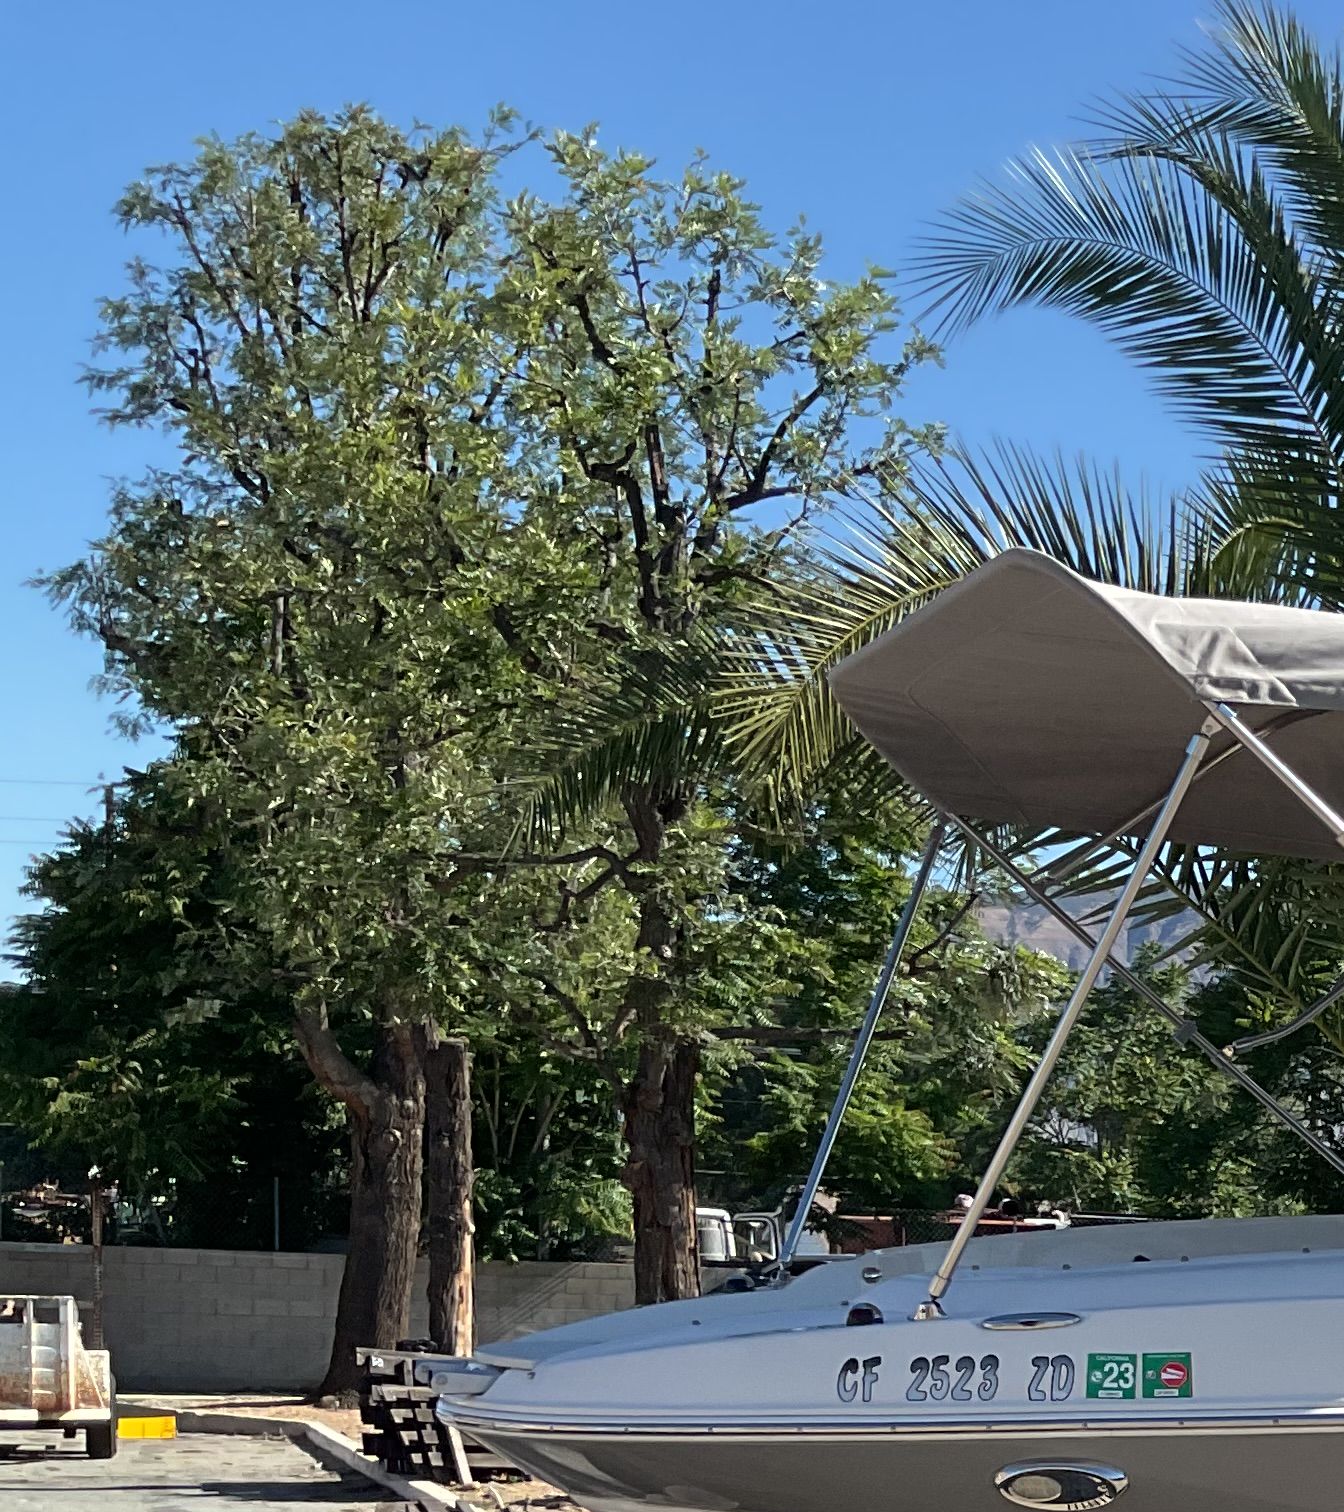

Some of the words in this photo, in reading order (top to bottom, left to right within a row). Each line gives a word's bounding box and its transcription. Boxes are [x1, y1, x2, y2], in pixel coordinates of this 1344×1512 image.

[836, 1356, 882, 1402] CF
[906, 1354, 1000, 1402] 2523
[1028, 1354, 1076, 1401] ZD
[1102, 1362, 1135, 1389] 23
